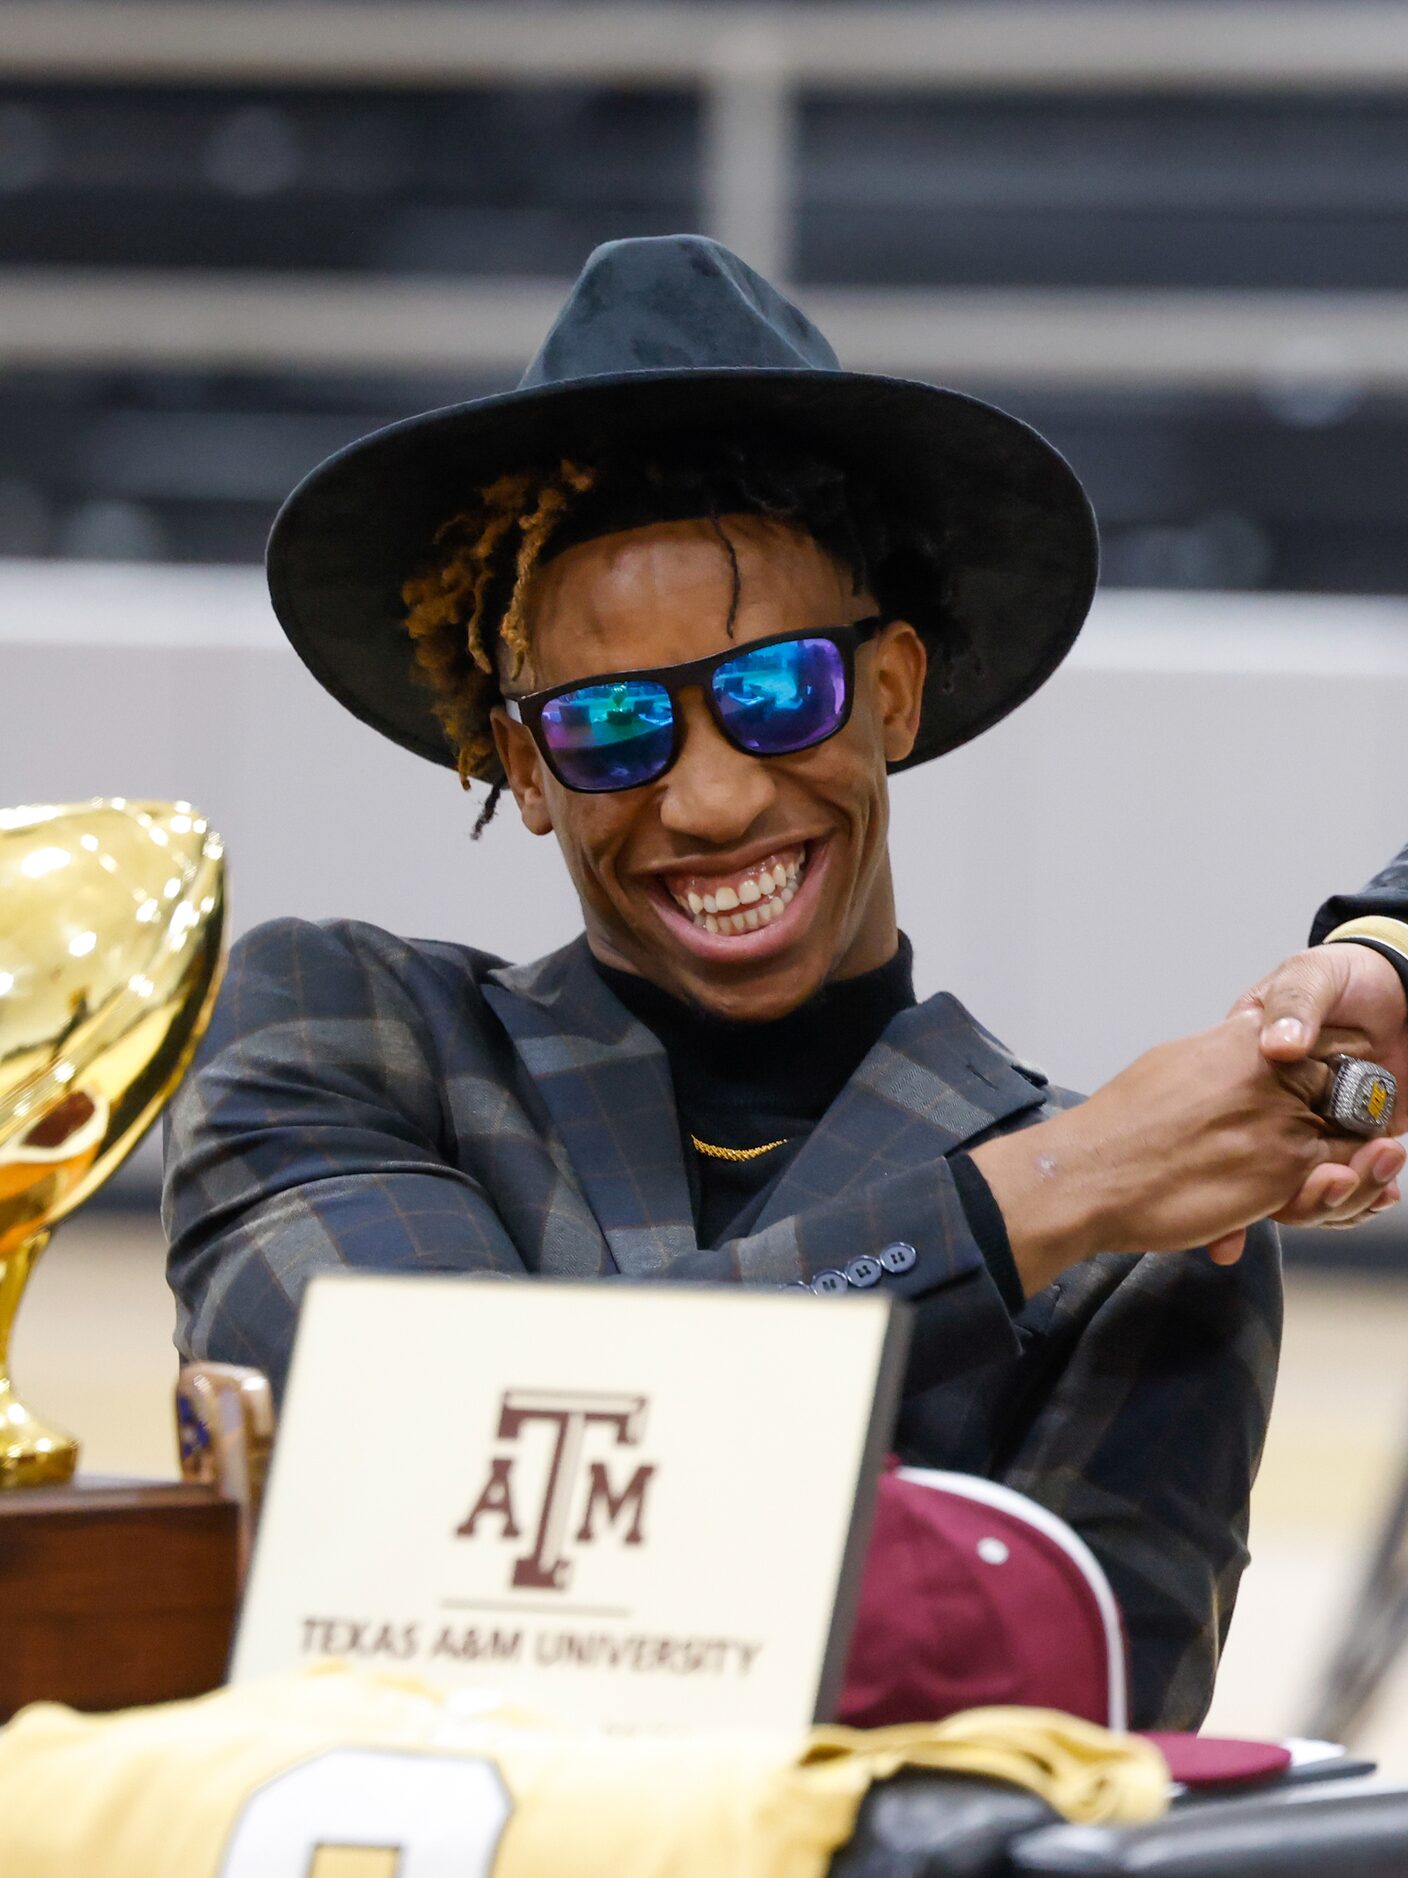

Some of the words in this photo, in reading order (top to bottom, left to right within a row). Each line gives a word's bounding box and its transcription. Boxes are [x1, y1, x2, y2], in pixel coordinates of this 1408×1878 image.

[301, 1616, 418, 1661] TEXAS
[430, 1624, 523, 1664] A&M
[533, 1629, 764, 1677] UNIVERSITY
